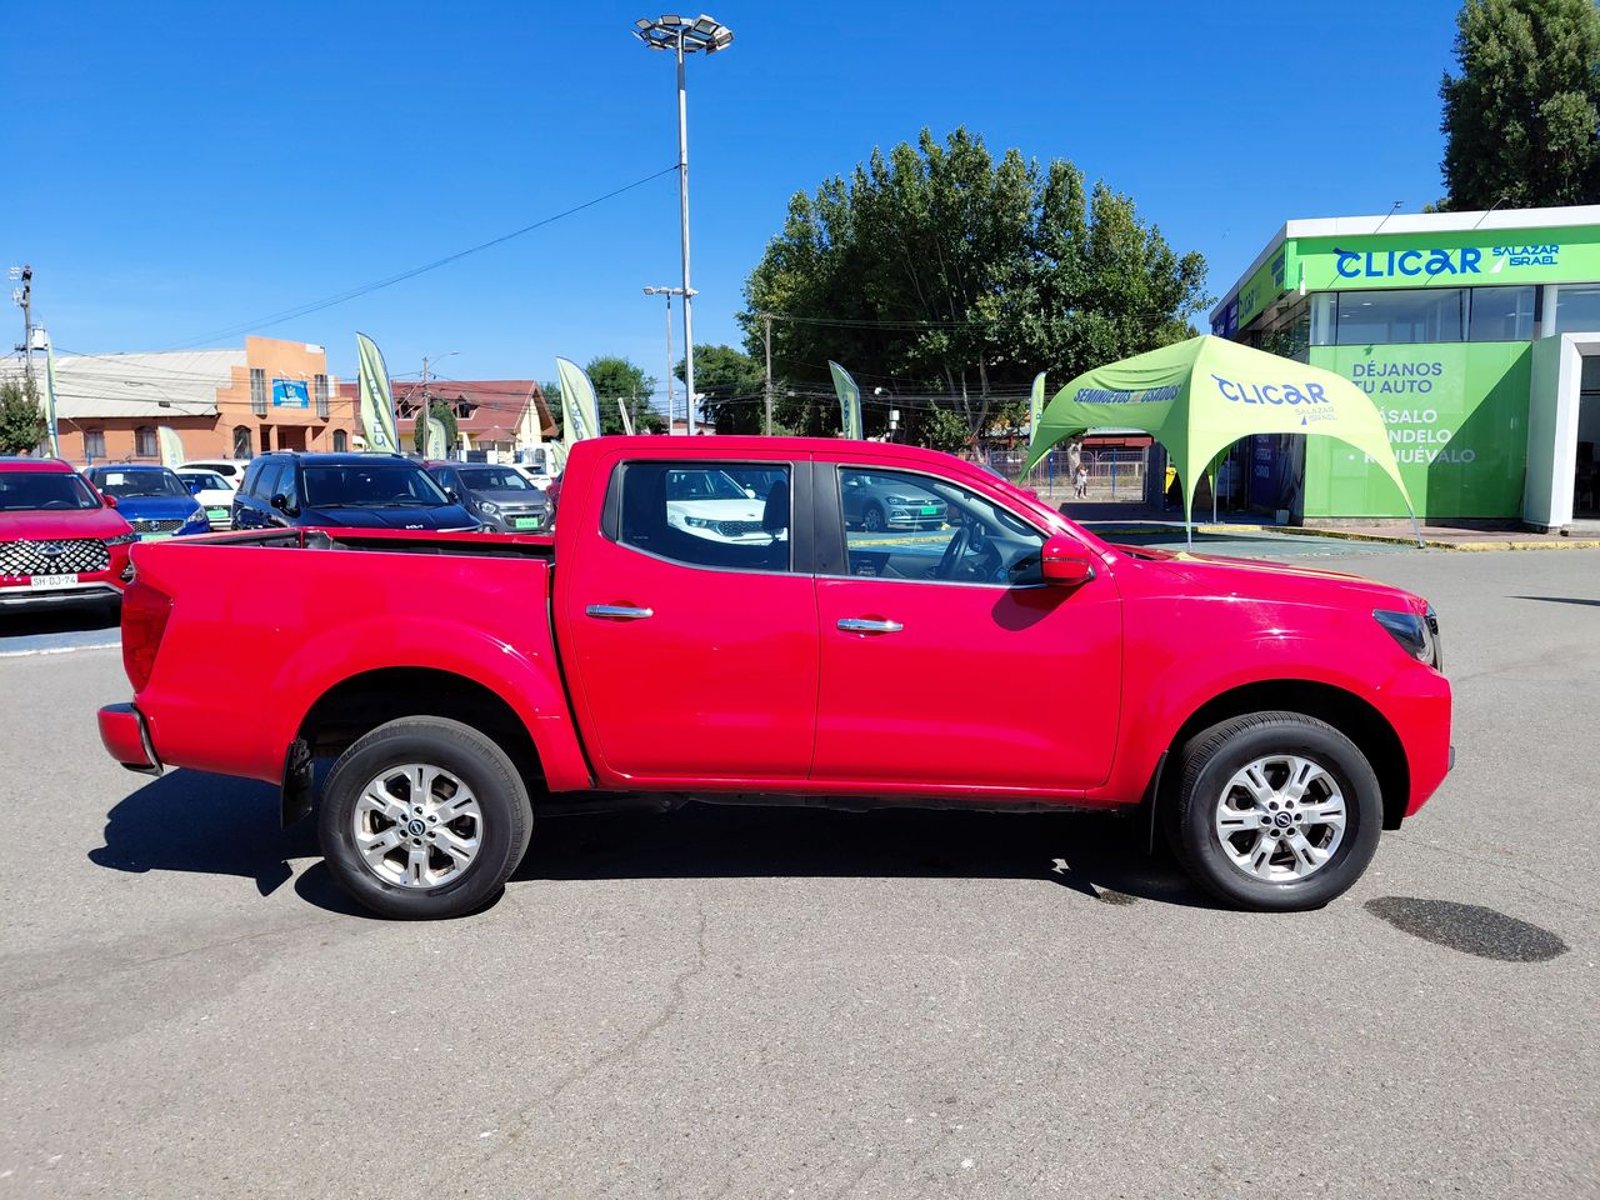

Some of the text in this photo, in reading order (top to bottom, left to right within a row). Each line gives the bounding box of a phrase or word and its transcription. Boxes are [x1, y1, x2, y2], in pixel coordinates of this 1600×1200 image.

[1492, 245, 1560, 257] SALAZAR
[1509, 255, 1558, 267] ISRAEL
[1352, 360, 1443, 377] DÉJANOS
[1379, 379, 1433, 394] AUTO
[1388, 429, 1452, 443] NDELO
